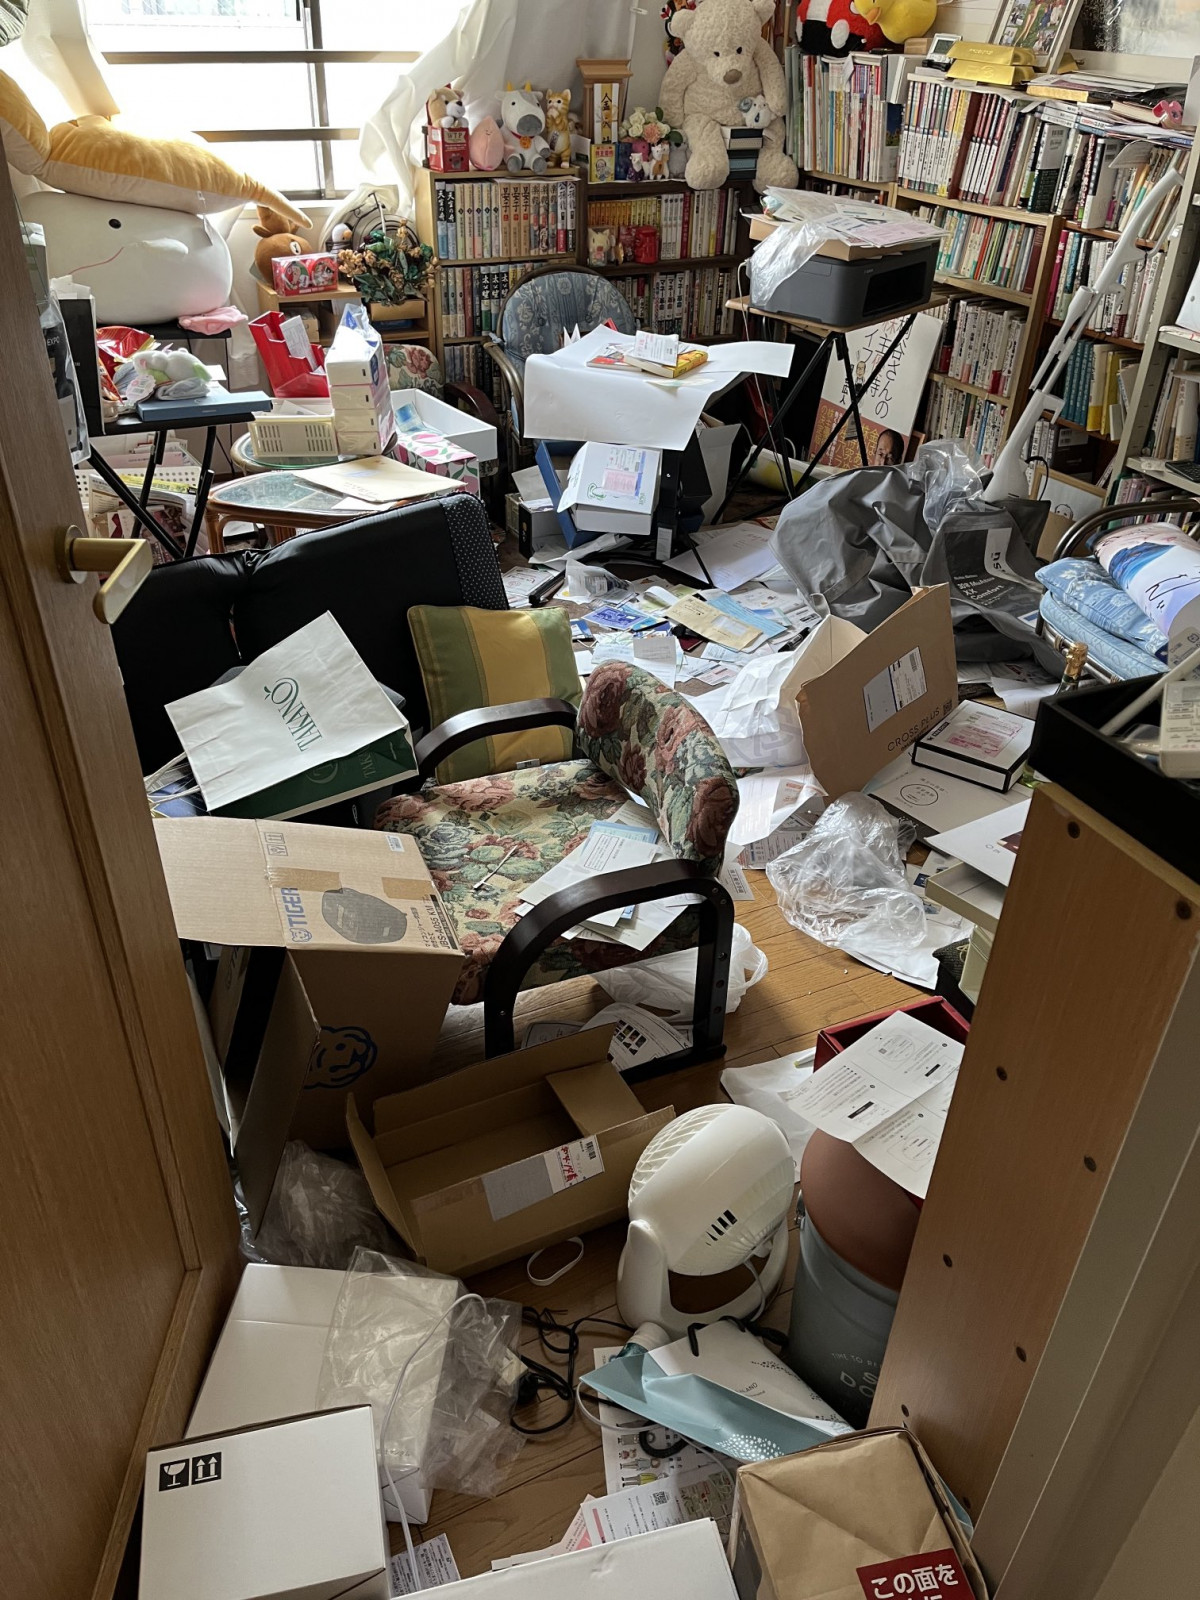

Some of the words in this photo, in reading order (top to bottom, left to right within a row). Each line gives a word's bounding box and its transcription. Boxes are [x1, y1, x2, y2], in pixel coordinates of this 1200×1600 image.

[271, 677, 322, 752] TAKANO
[887, 723, 918, 752] CROSS
[919, 707, 940, 733] PLUS
[281, 887, 308, 927] TIGER
[831, 1353, 848, 1361] TIME
[851, 1355, 863, 1364] TO
[871, 1563, 959, 1599] この面を
